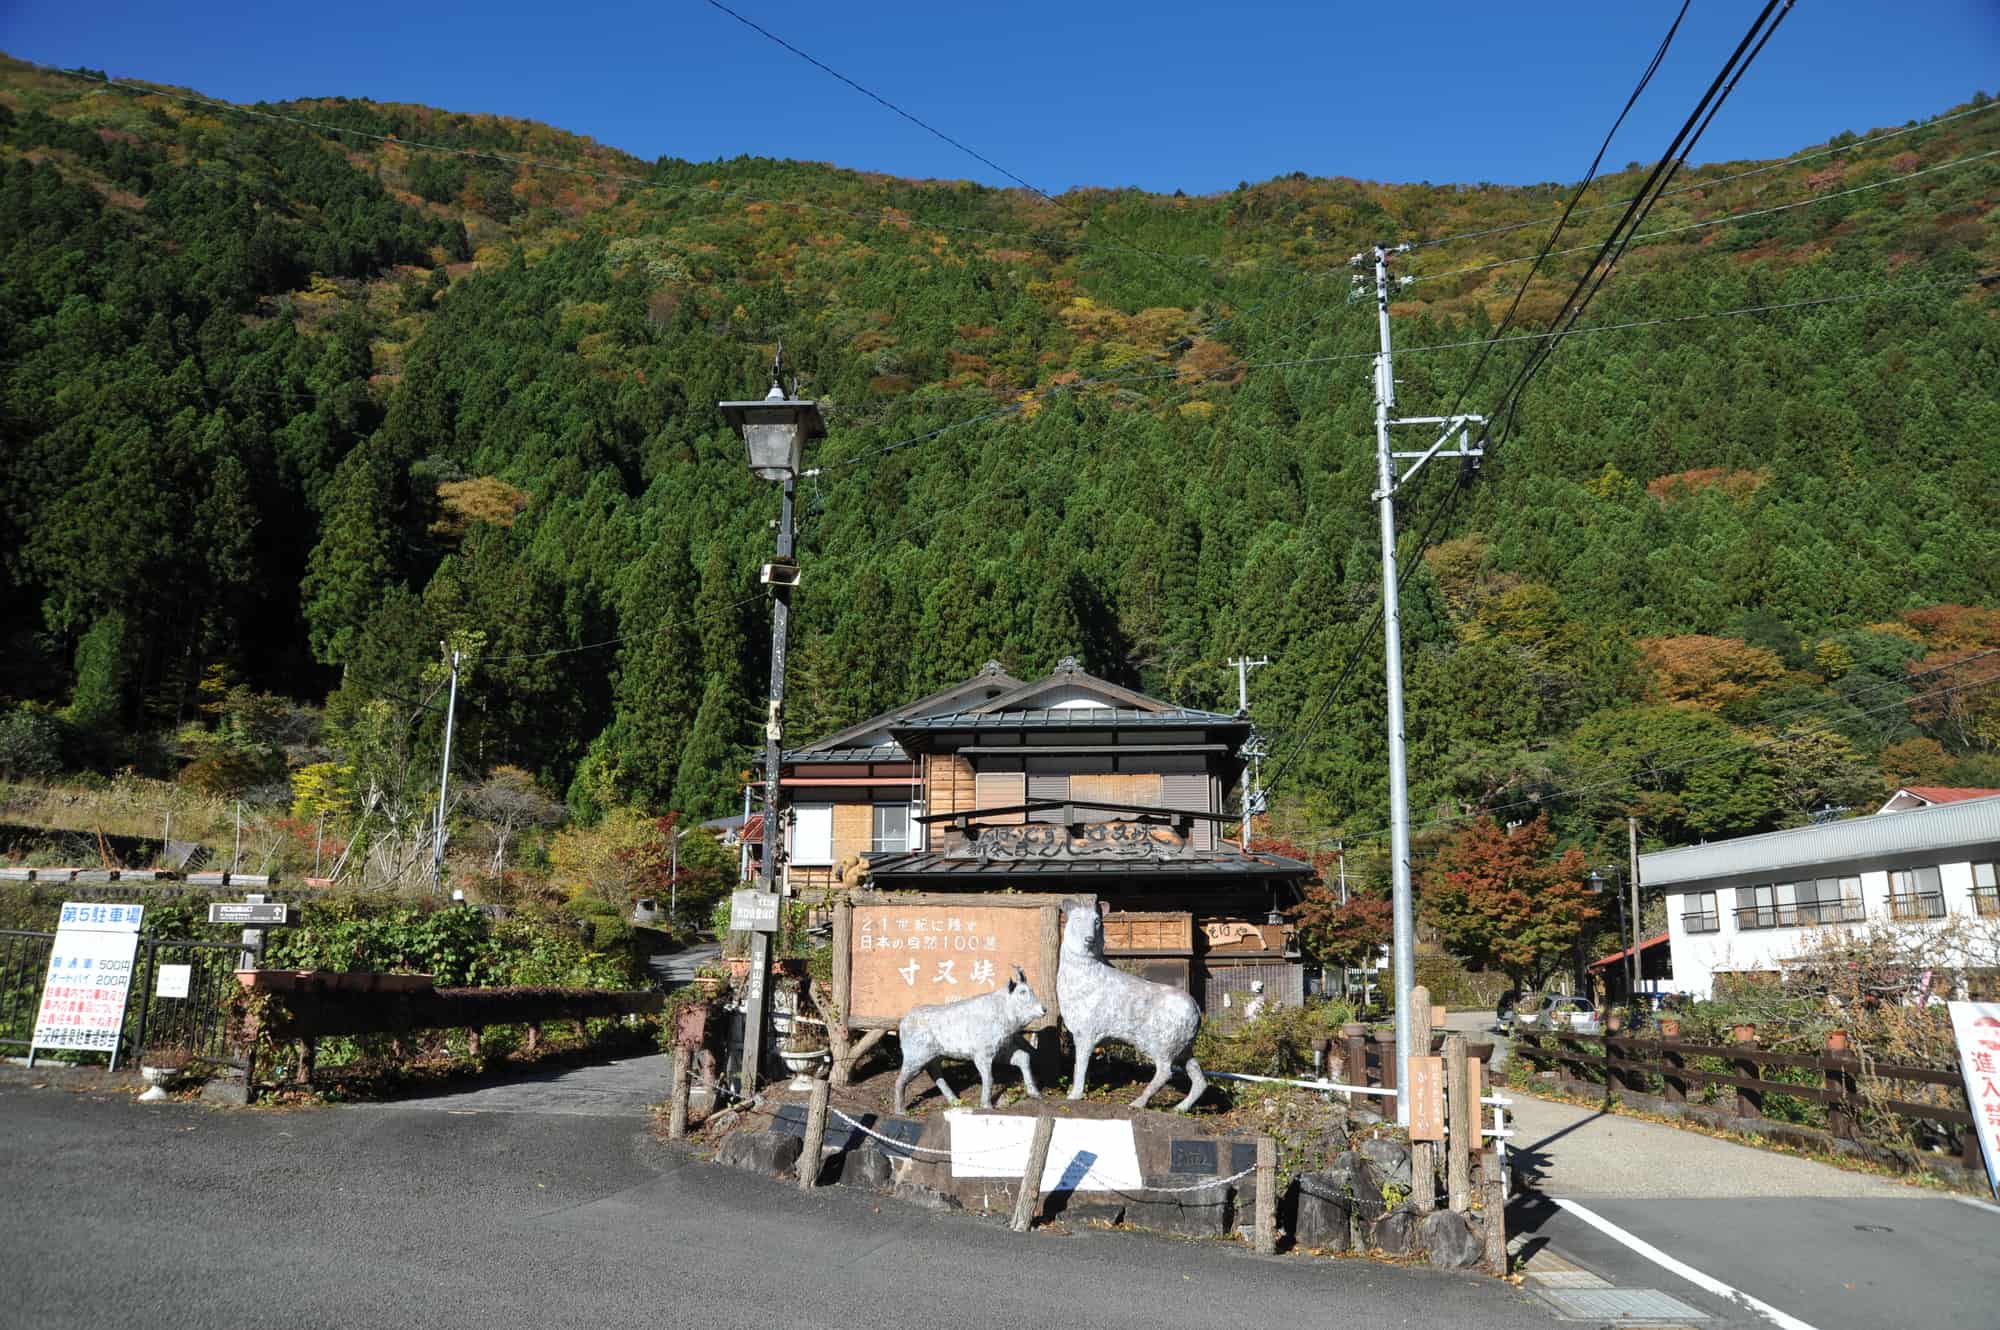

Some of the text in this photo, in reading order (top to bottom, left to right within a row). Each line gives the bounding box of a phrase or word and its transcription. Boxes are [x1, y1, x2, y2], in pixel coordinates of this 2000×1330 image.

[62, 905, 141, 924] 第5駐車場
[99, 959, 130, 972] 500円
[897, 957, 996, 988] 寸又峡
[96, 975, 127, 987] 200円
